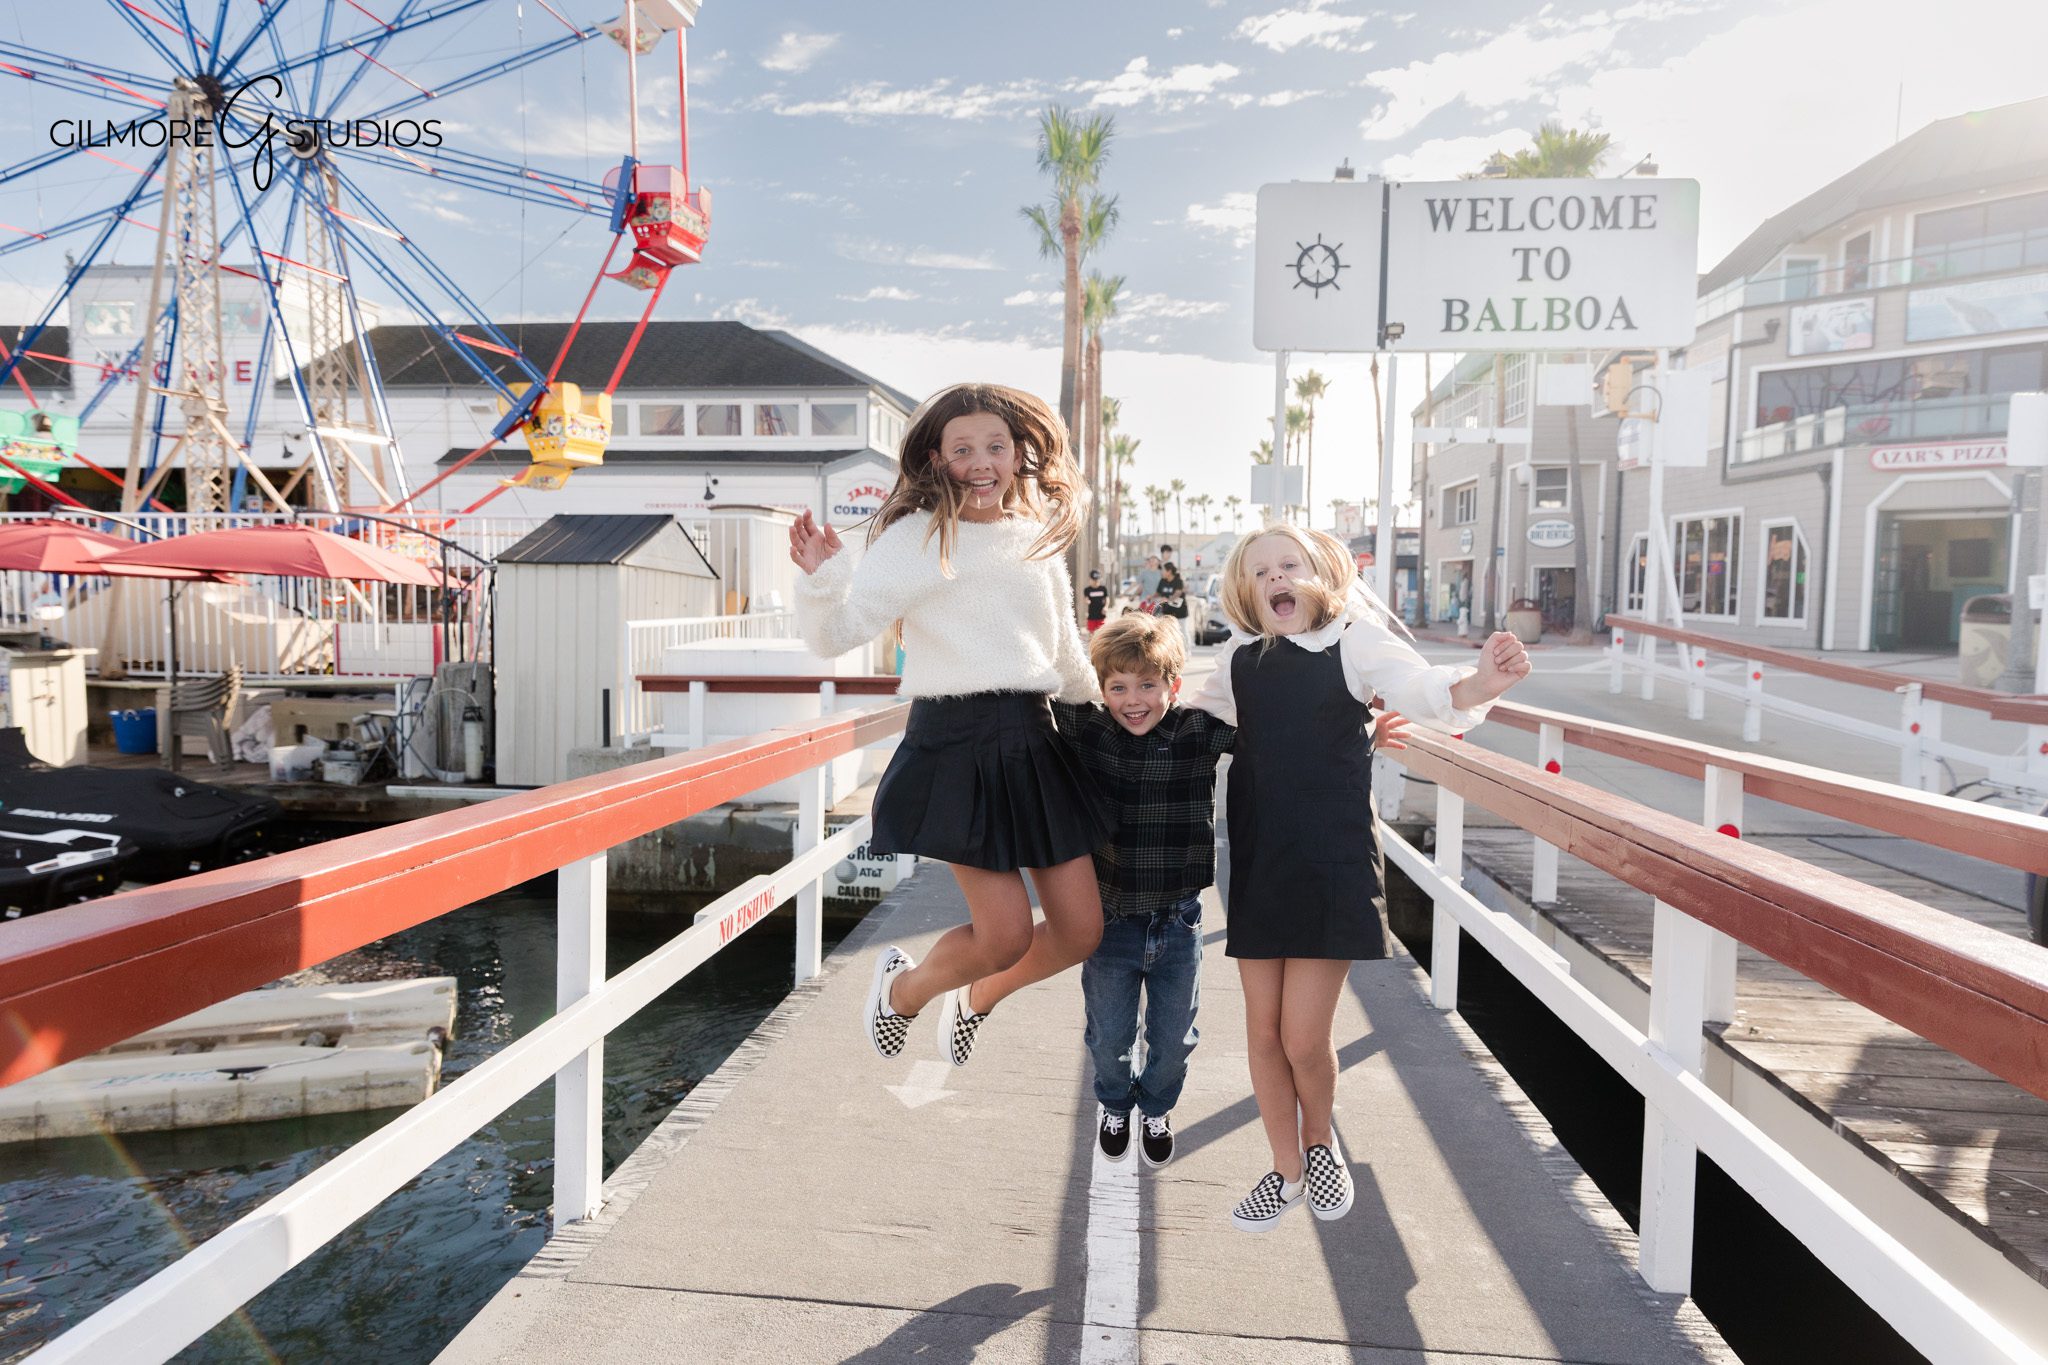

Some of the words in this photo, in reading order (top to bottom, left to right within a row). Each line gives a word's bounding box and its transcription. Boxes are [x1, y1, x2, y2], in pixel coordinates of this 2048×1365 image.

[1424, 194, 1658, 233] WELCOME
[1512, 246, 1571, 282] TO
[1440, 296, 1638, 333] BALBOA
[1880, 449, 1944, 464] AZAR'S
[859, 867, 884, 878] AT&T
[837, 885, 861, 898] CALL
[863, 886, 881, 899] 811
[719, 914, 734, 947] NO
[736, 886, 776, 934] FISHING
